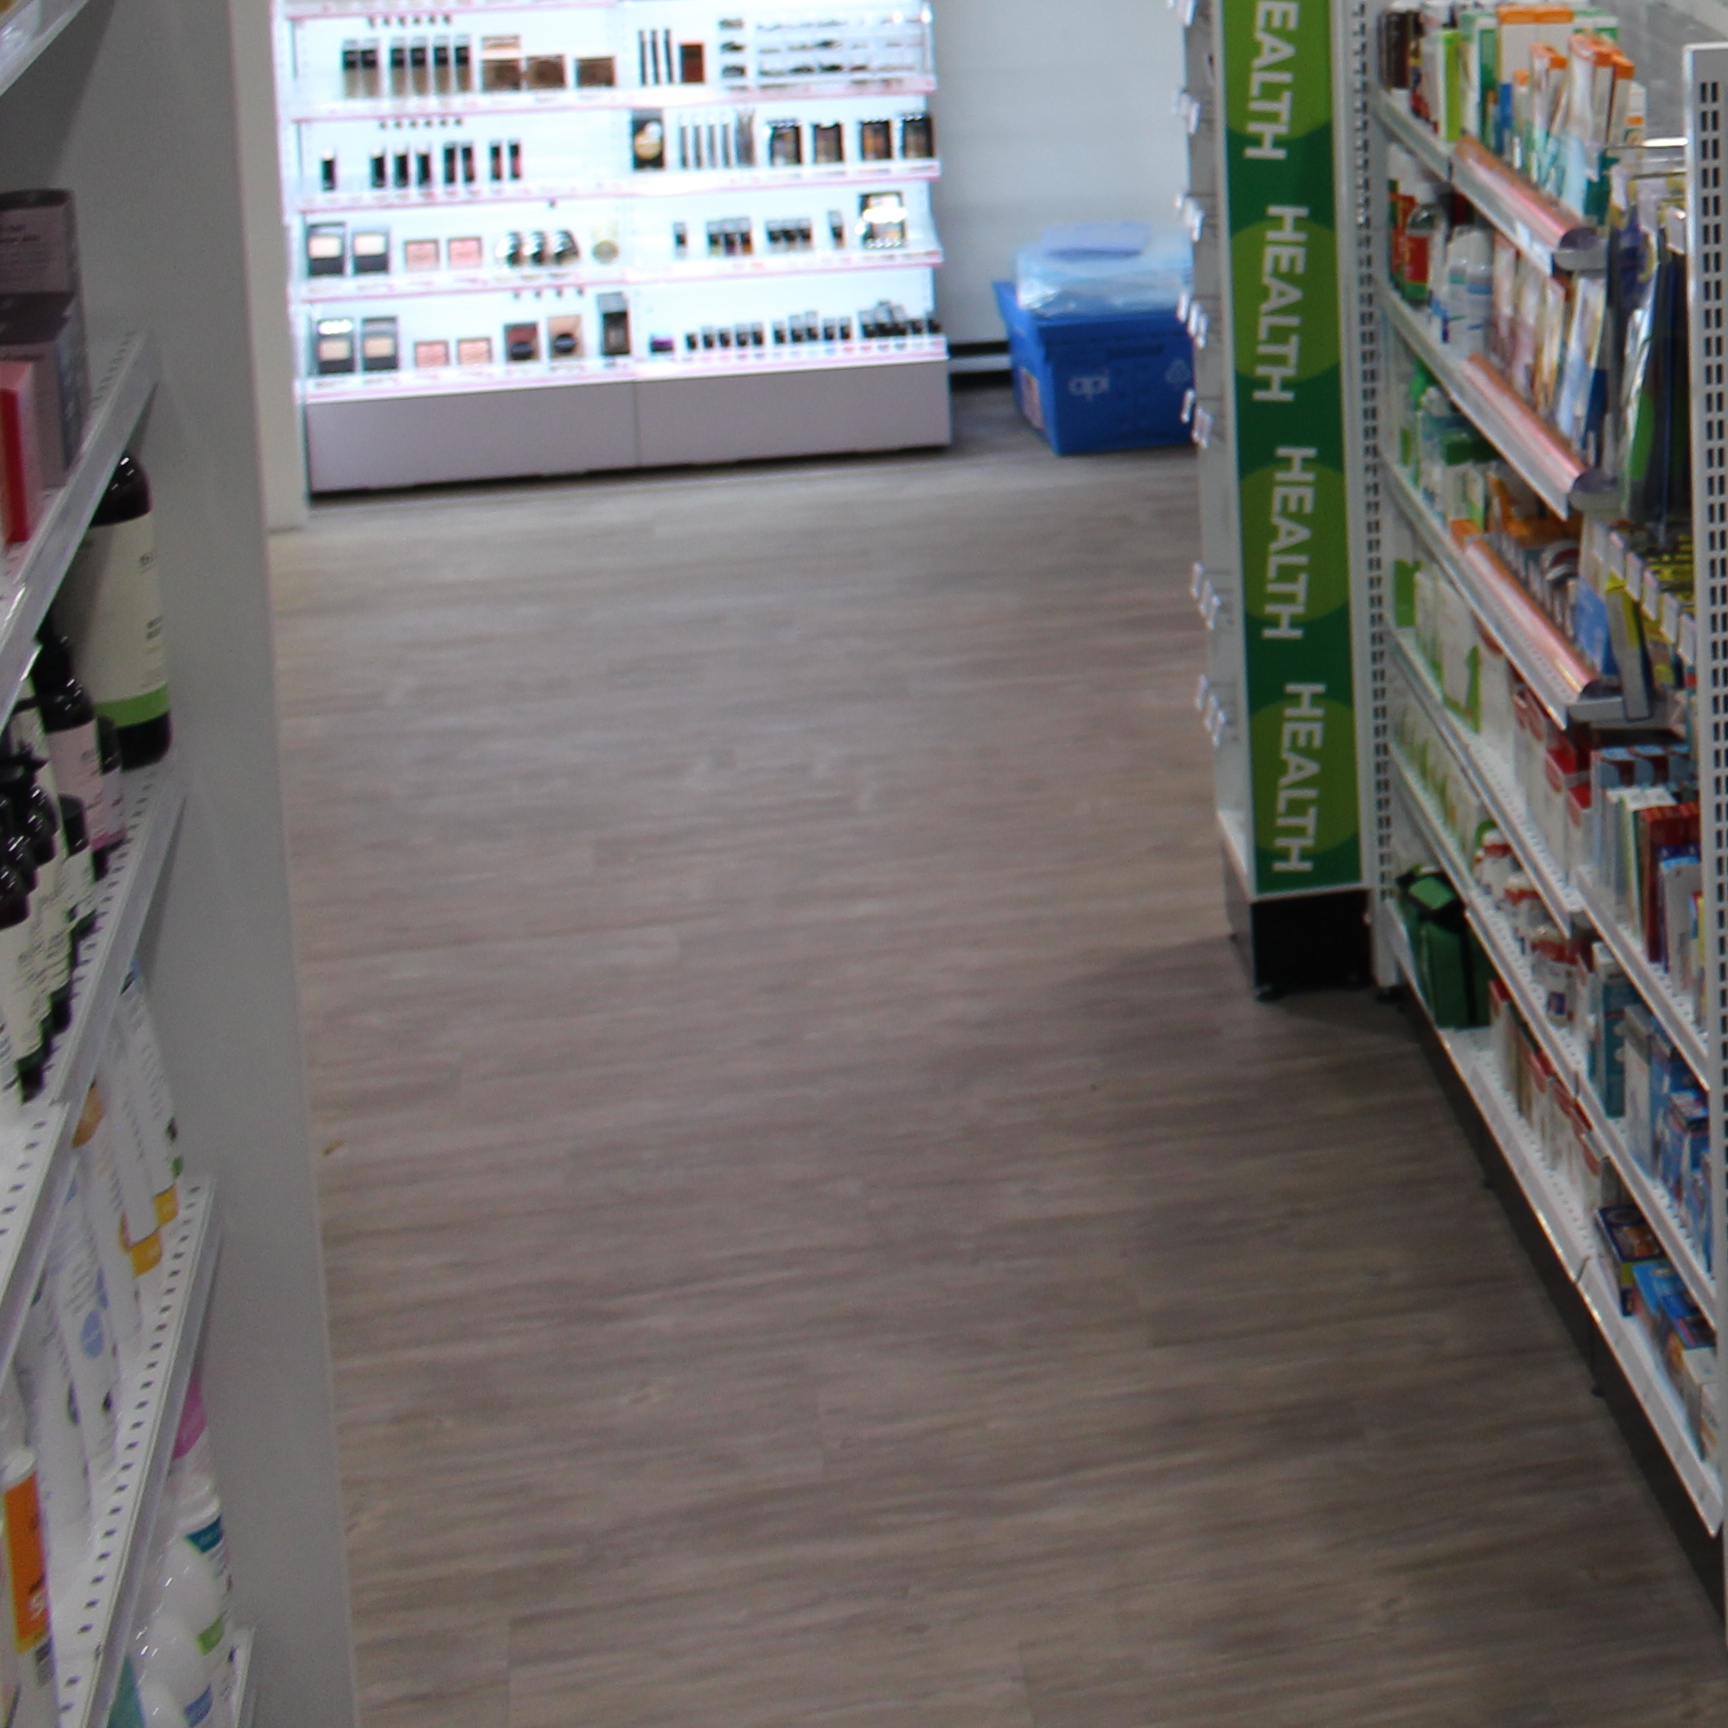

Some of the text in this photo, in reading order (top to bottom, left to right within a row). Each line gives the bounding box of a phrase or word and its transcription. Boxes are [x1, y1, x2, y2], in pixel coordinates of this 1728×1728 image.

[1252, 205, 1309, 403] HEALTH
[1262, 445, 1318, 641] HEALTH
[1272, 682, 1326, 872] HEALTH
